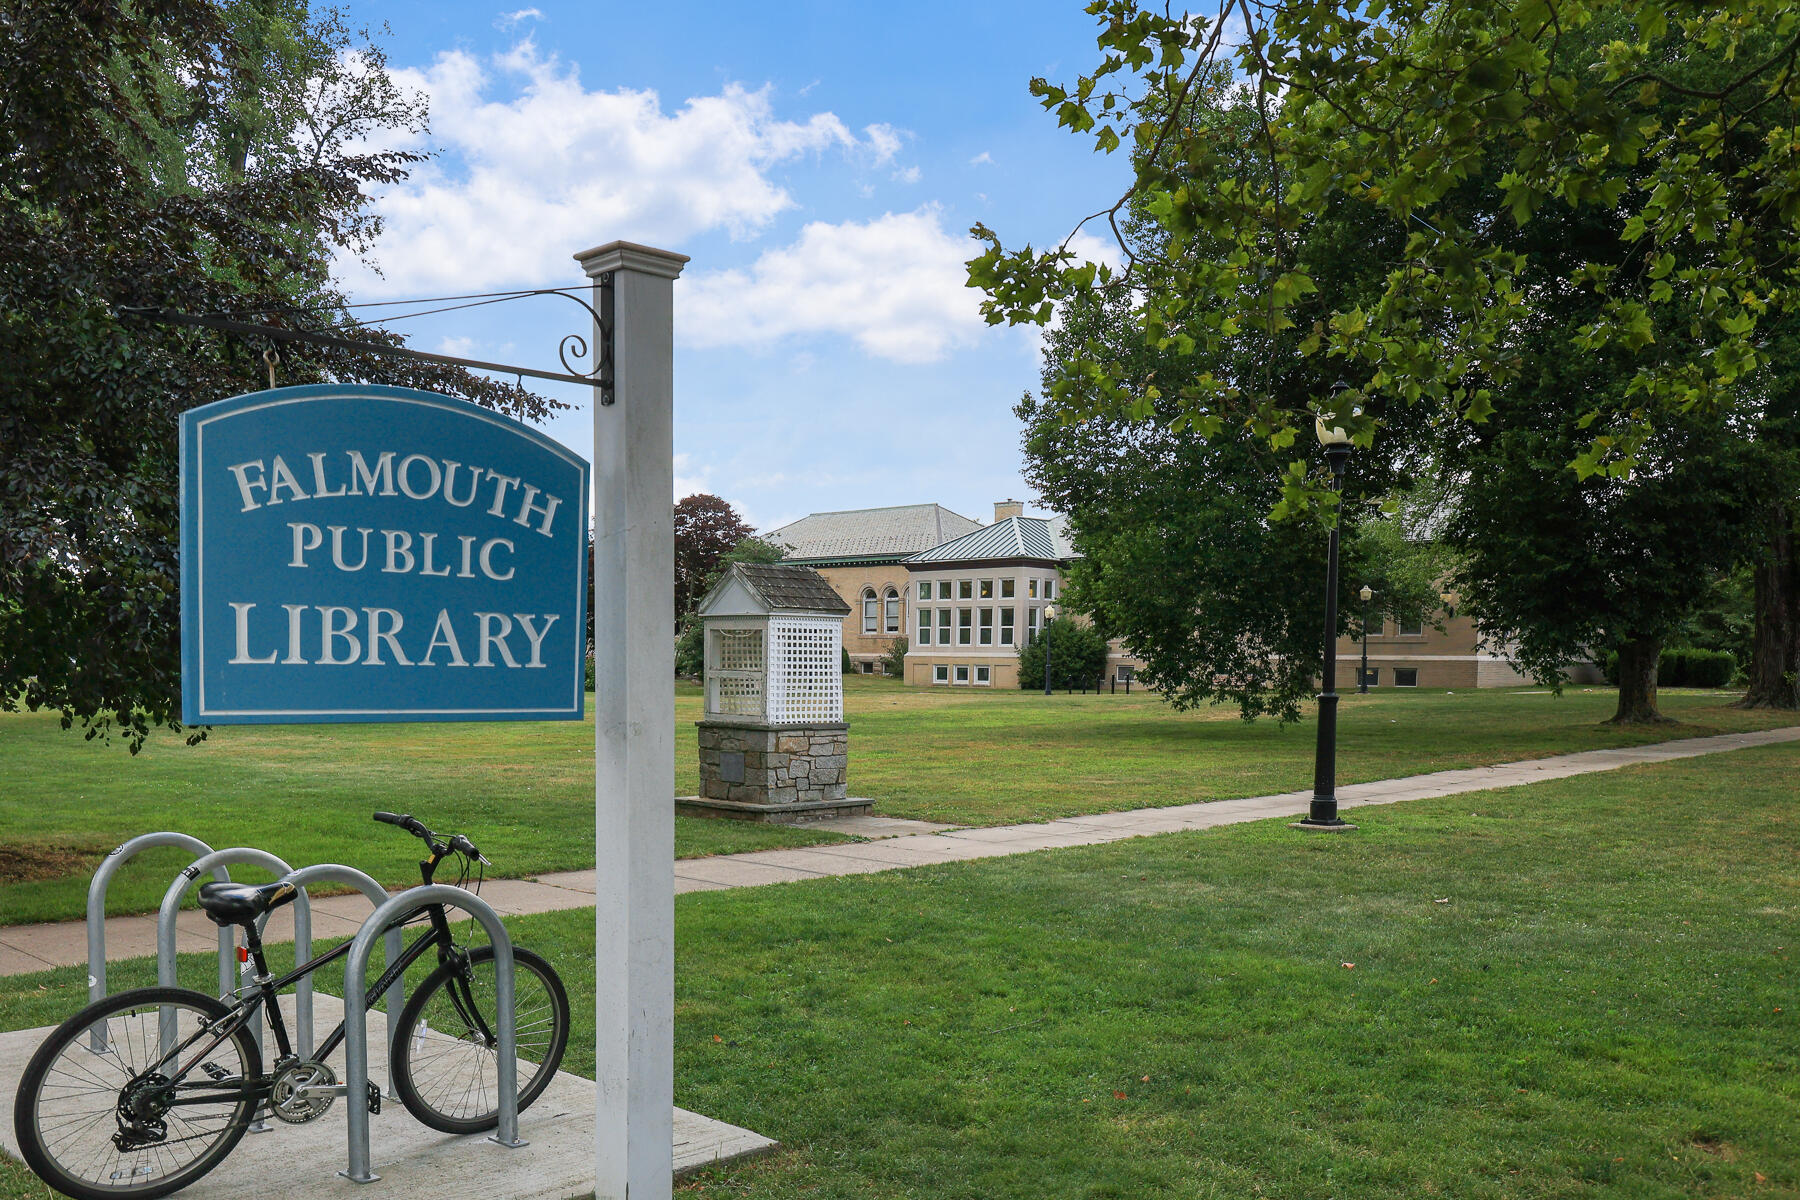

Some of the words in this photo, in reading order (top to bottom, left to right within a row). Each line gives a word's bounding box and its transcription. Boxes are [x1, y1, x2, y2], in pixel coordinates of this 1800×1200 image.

[227, 450, 563, 538] FALMOUTH
[286, 522, 515, 581] PUBLIC
[228, 602, 560, 668] LIBRARY
